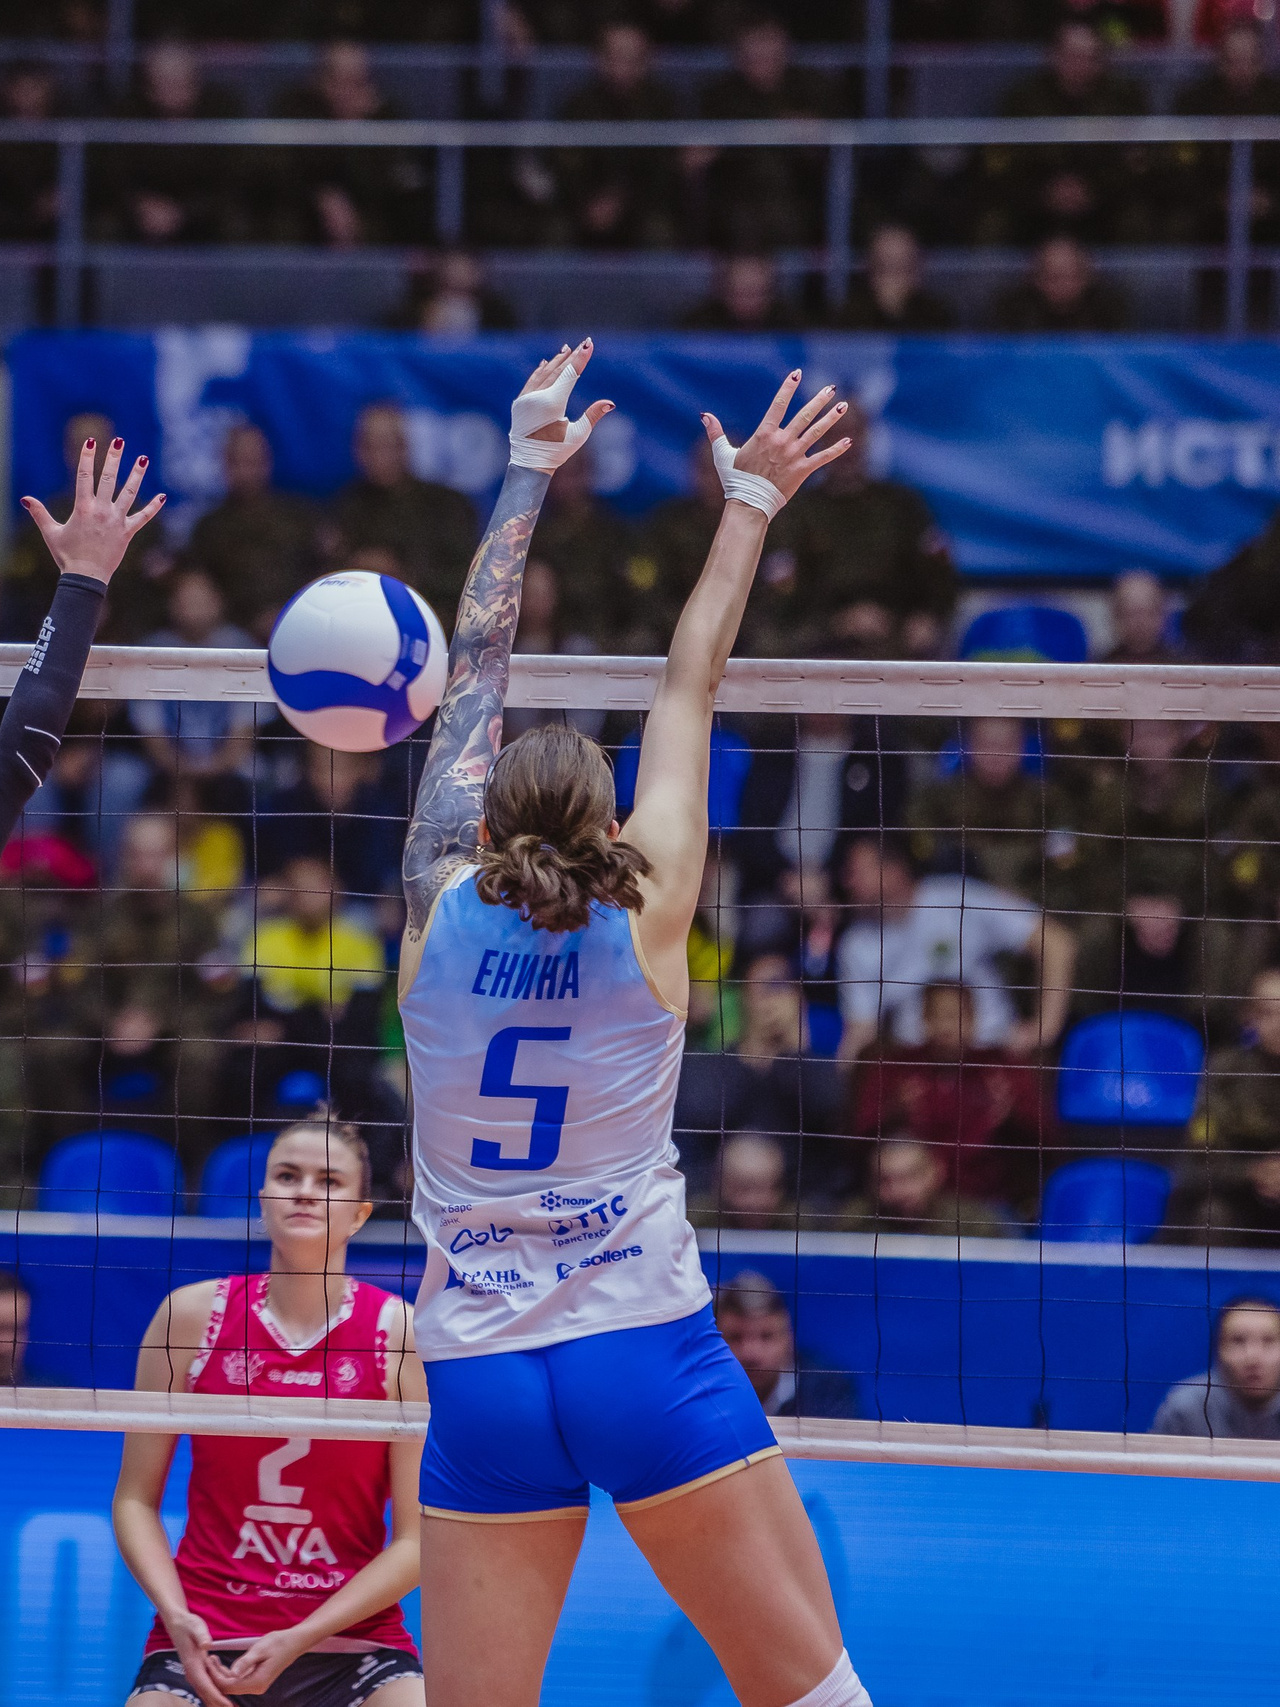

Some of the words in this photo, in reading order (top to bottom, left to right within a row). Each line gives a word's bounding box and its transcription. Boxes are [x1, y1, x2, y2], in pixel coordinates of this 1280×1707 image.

[1101, 420, 1280, 489] ИСТ
[471, 950, 580, 999] ЕНИНА
[470, 1026, 572, 1171] 5
[579, 1245, 643, 1268] sollers
[258, 1438, 311, 1505] 2
[232, 1521, 338, 1566] AVA
[275, 1571, 345, 1589] GROUP
